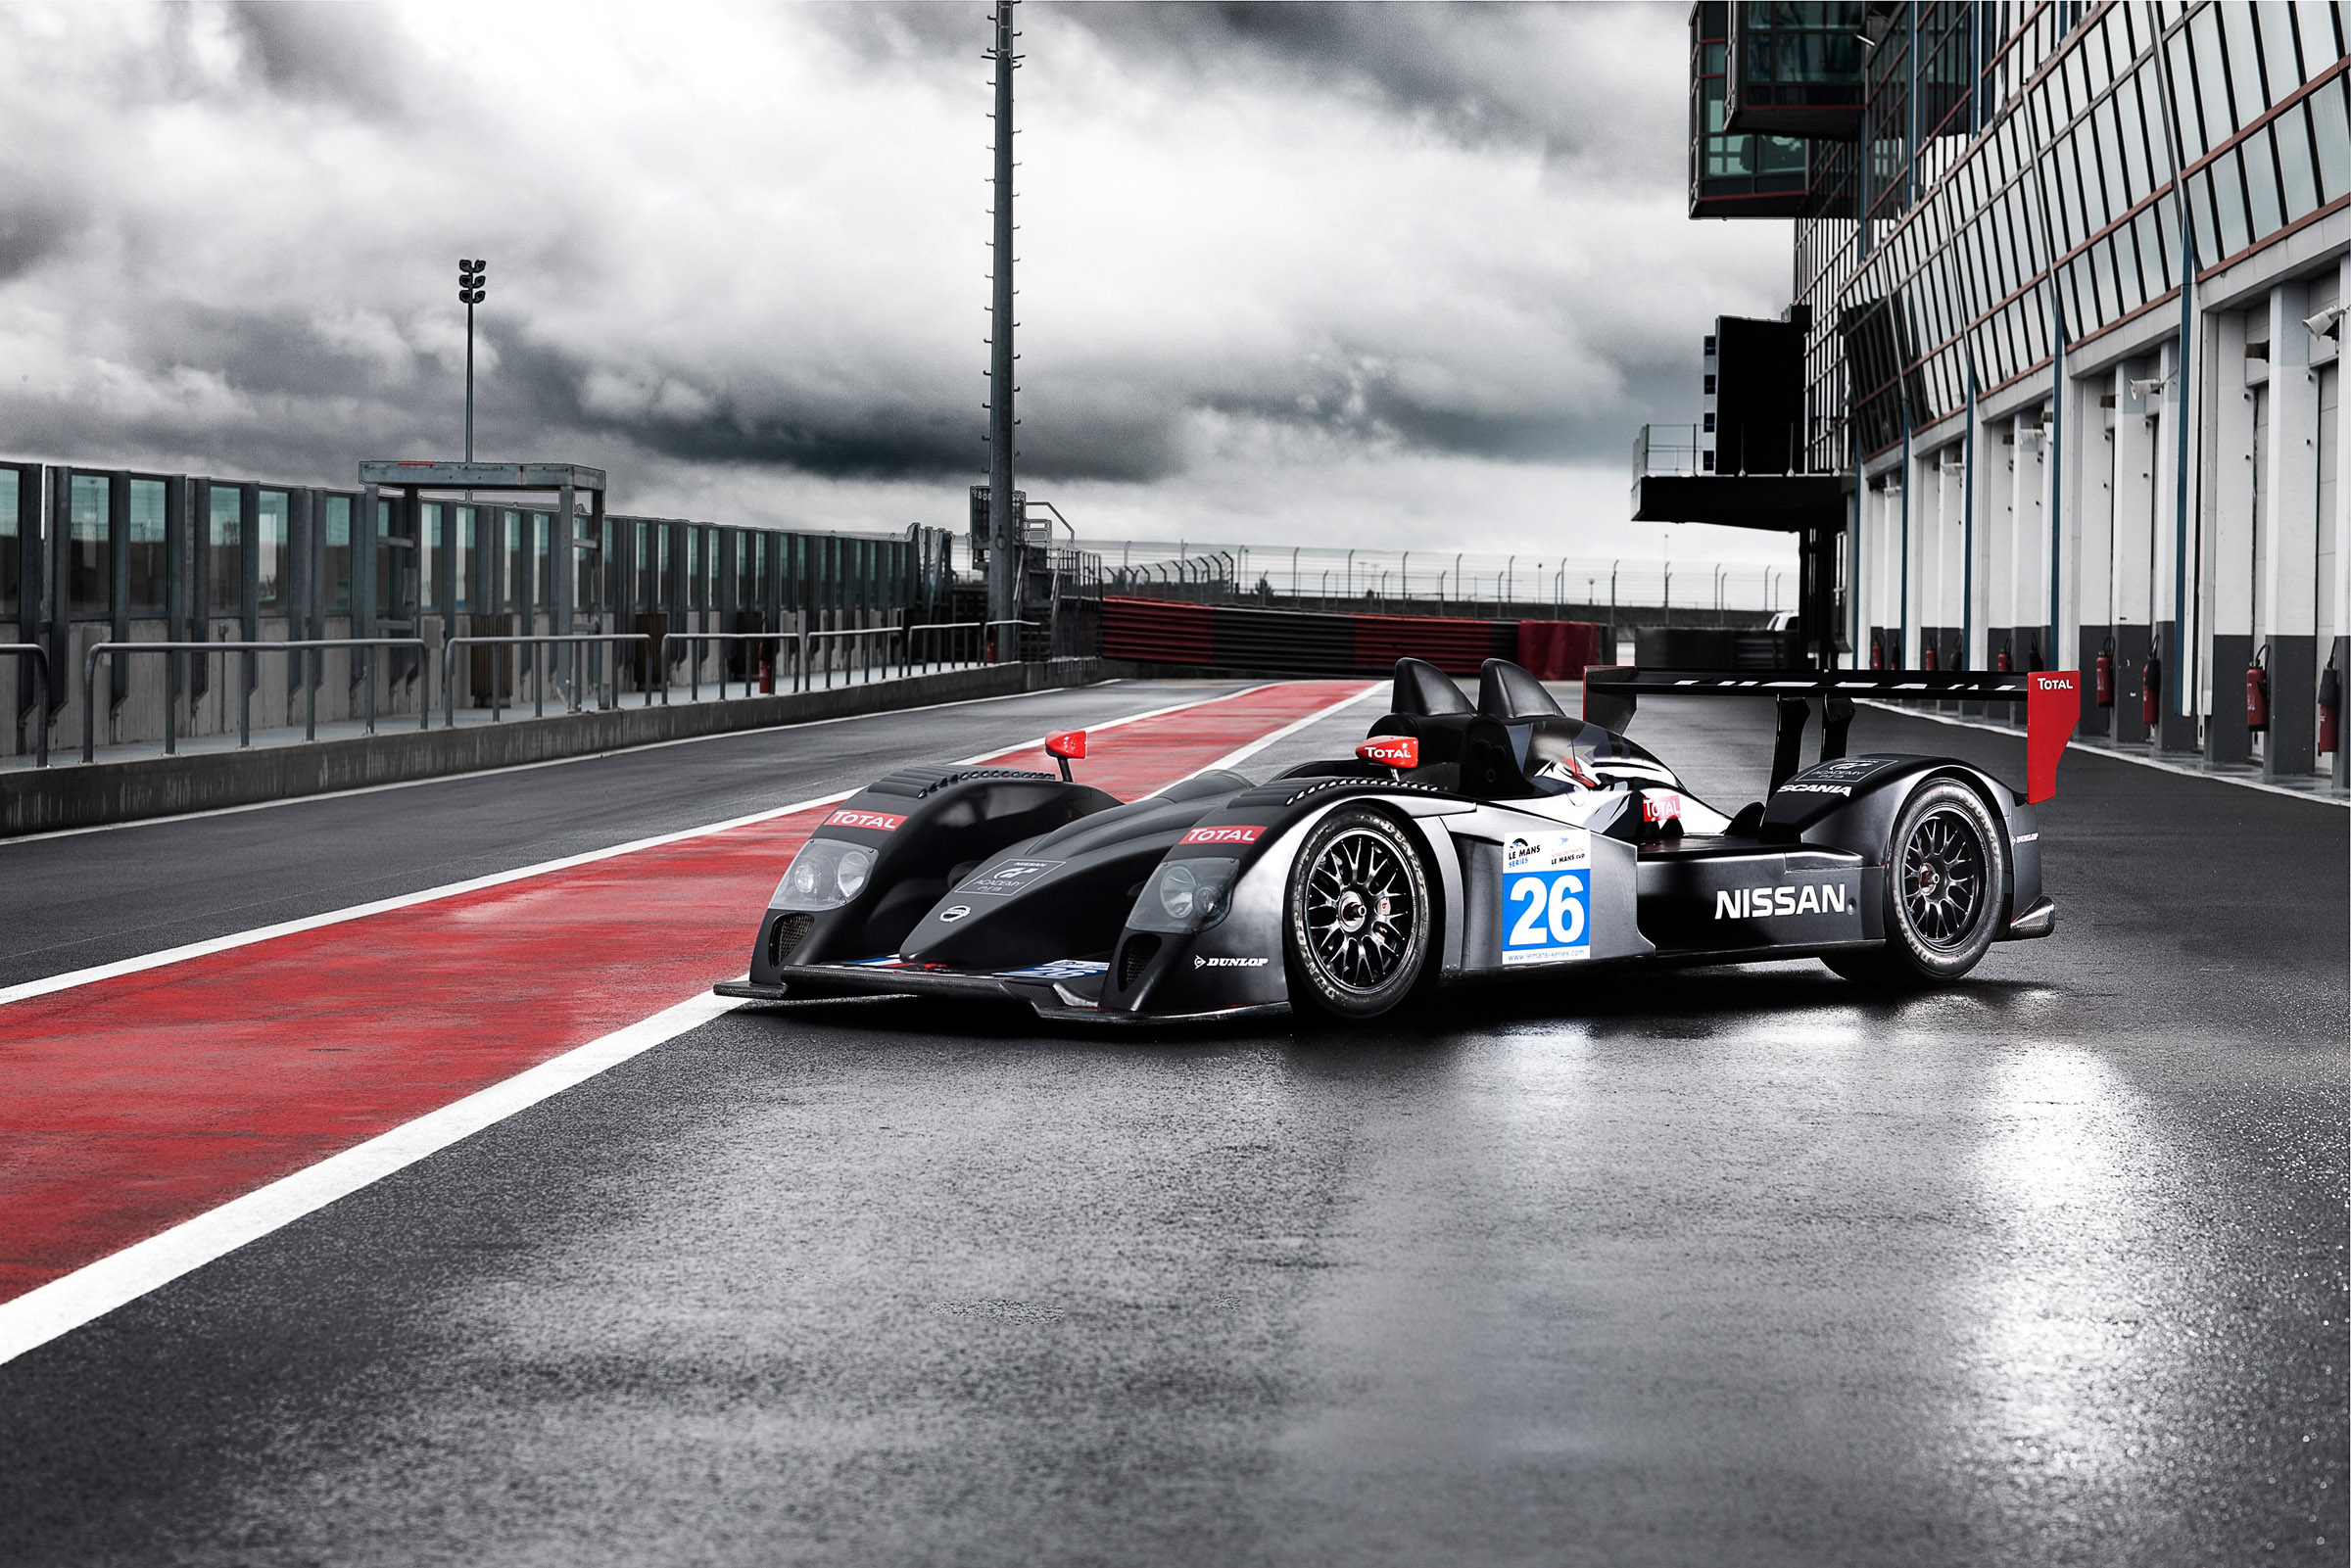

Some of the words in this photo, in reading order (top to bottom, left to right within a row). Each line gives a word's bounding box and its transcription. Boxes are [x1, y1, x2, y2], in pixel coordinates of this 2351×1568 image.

[2037, 677, 2074, 690] TOTAL
[1365, 746, 1412, 758] TOTAL
[1777, 784, 1852, 797] SCANIA
[1643, 798, 1681, 818] TOTAL
[832, 811, 895, 830] TOTAL
[1188, 828, 1256, 842] TOTAL
[1508, 851, 1516, 861] LE
[1519, 844, 1541, 858] MANS
[1559, 854, 1575, 864] MANS
[1509, 857, 1529, 869] SERIES
[973, 879, 1026, 887] ACADEMY
[1714, 883, 1846, 920] NISSAN
[1509, 875, 1585, 946] 26
[1508, 949, 1586, 962] www.lemans-series.com
[1207, 958, 1269, 967] DUNLOP
